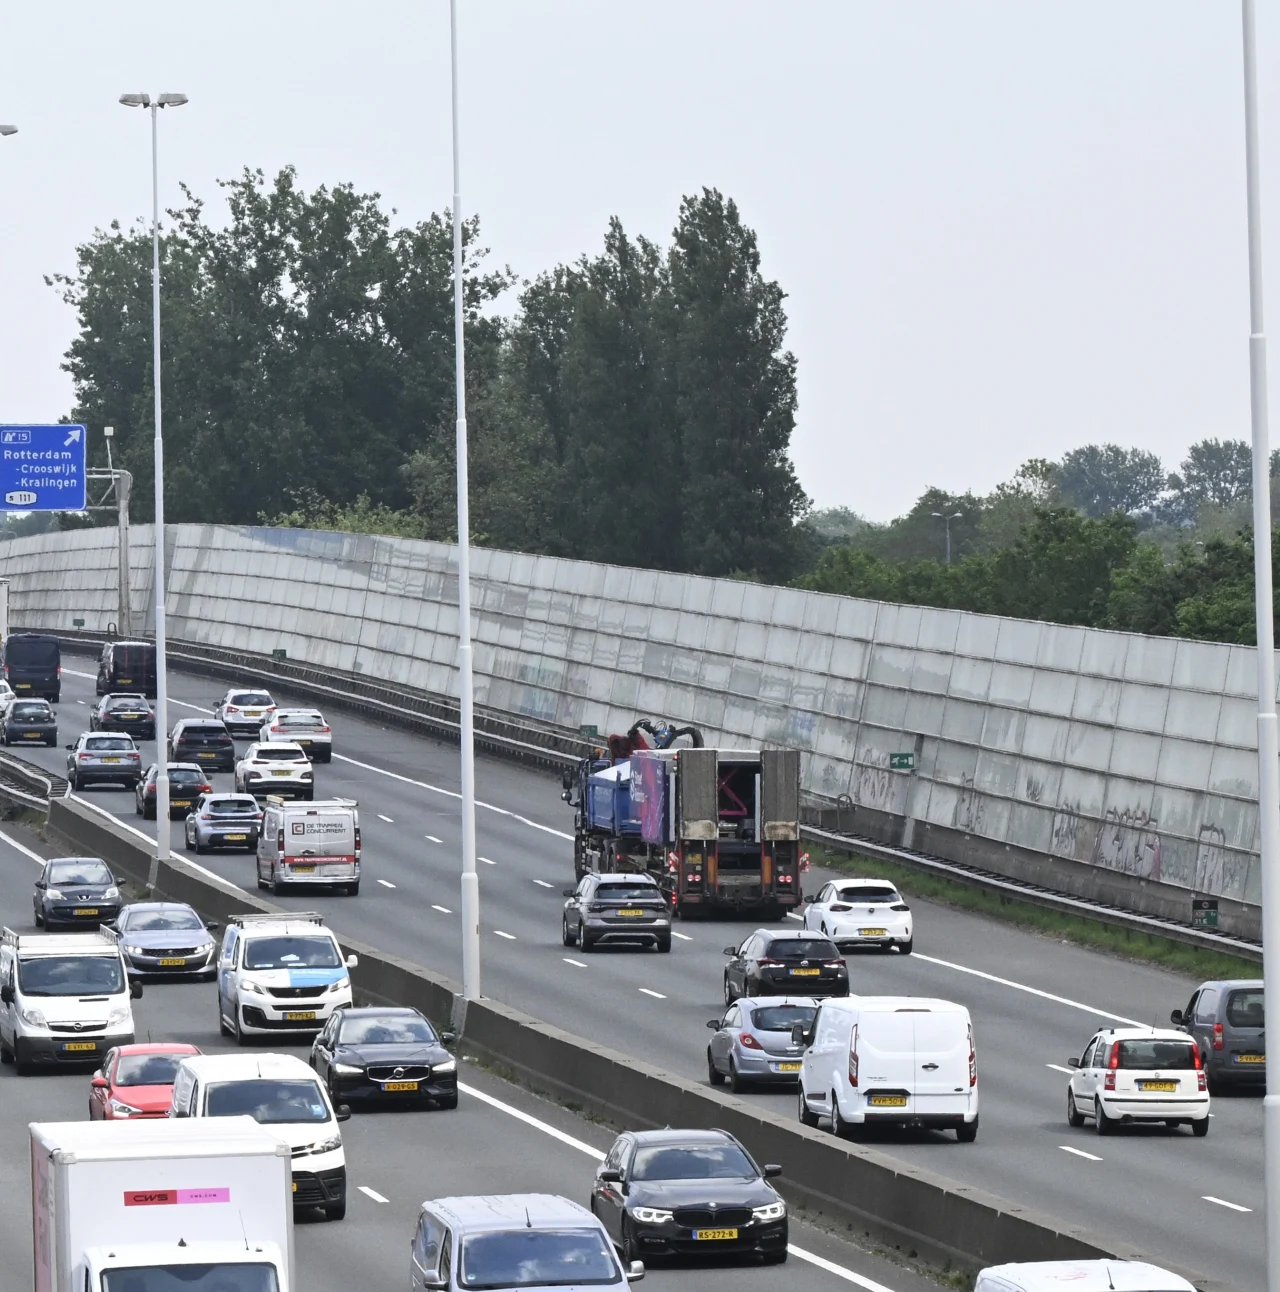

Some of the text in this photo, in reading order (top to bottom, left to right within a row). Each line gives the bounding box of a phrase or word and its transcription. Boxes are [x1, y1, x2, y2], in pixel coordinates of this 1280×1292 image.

[18, 433, 28, 441] 15
[3, 450, 72, 460] Rotterdam
[133, 1193, 169, 1203] CWS
[699, 1229, 734, 1238] RS-272-R
